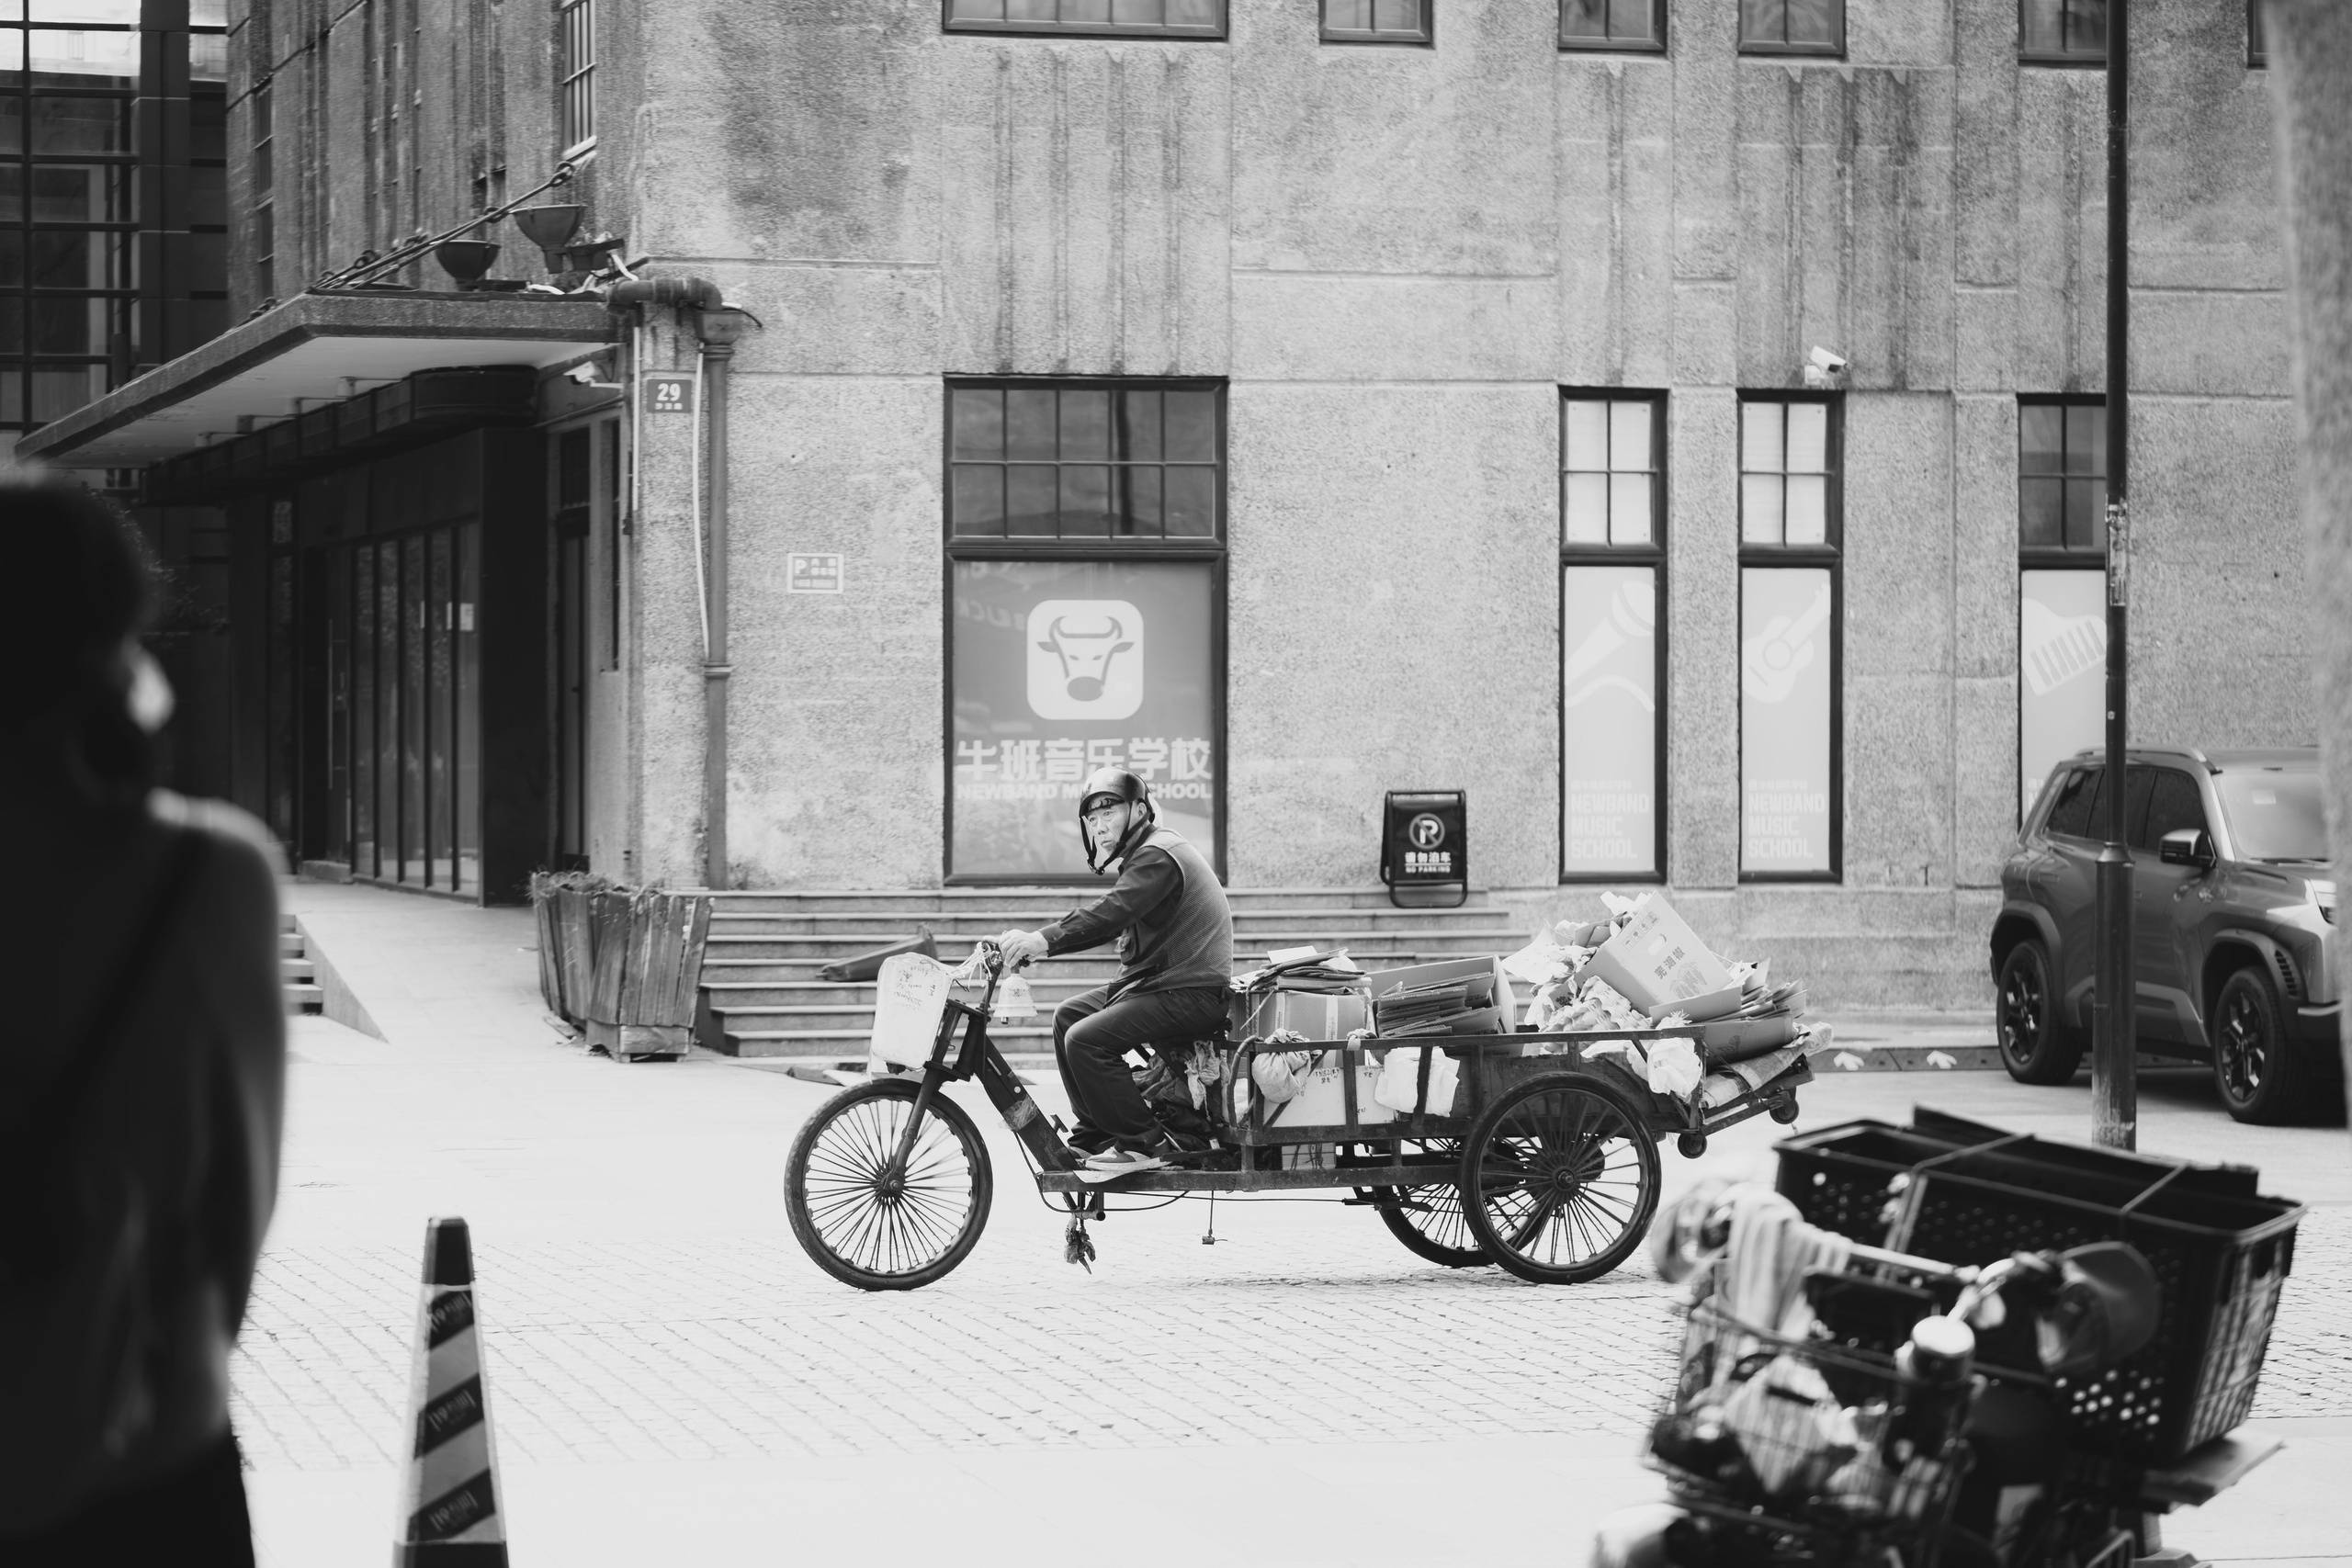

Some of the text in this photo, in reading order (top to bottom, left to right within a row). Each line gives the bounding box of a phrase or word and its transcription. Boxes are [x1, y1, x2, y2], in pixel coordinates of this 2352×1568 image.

[657, 382, 681, 401] 29
[795, 559, 808, 574] P
[956, 738, 1212, 781] 牛班音乐学校
[956, 784, 1058, 800] NEWBAND
[1147, 783, 1212, 800] CHOOL
[1571, 793, 1649, 814] NEWBAND
[1747, 793, 1826, 814] NEWBAND
[1571, 816, 1623, 836] MUSIC
[1747, 815, 1800, 836] MUSIC
[1571, 838, 1638, 859] SCHOOL
[1747, 838, 1815, 859] SCHOOL
